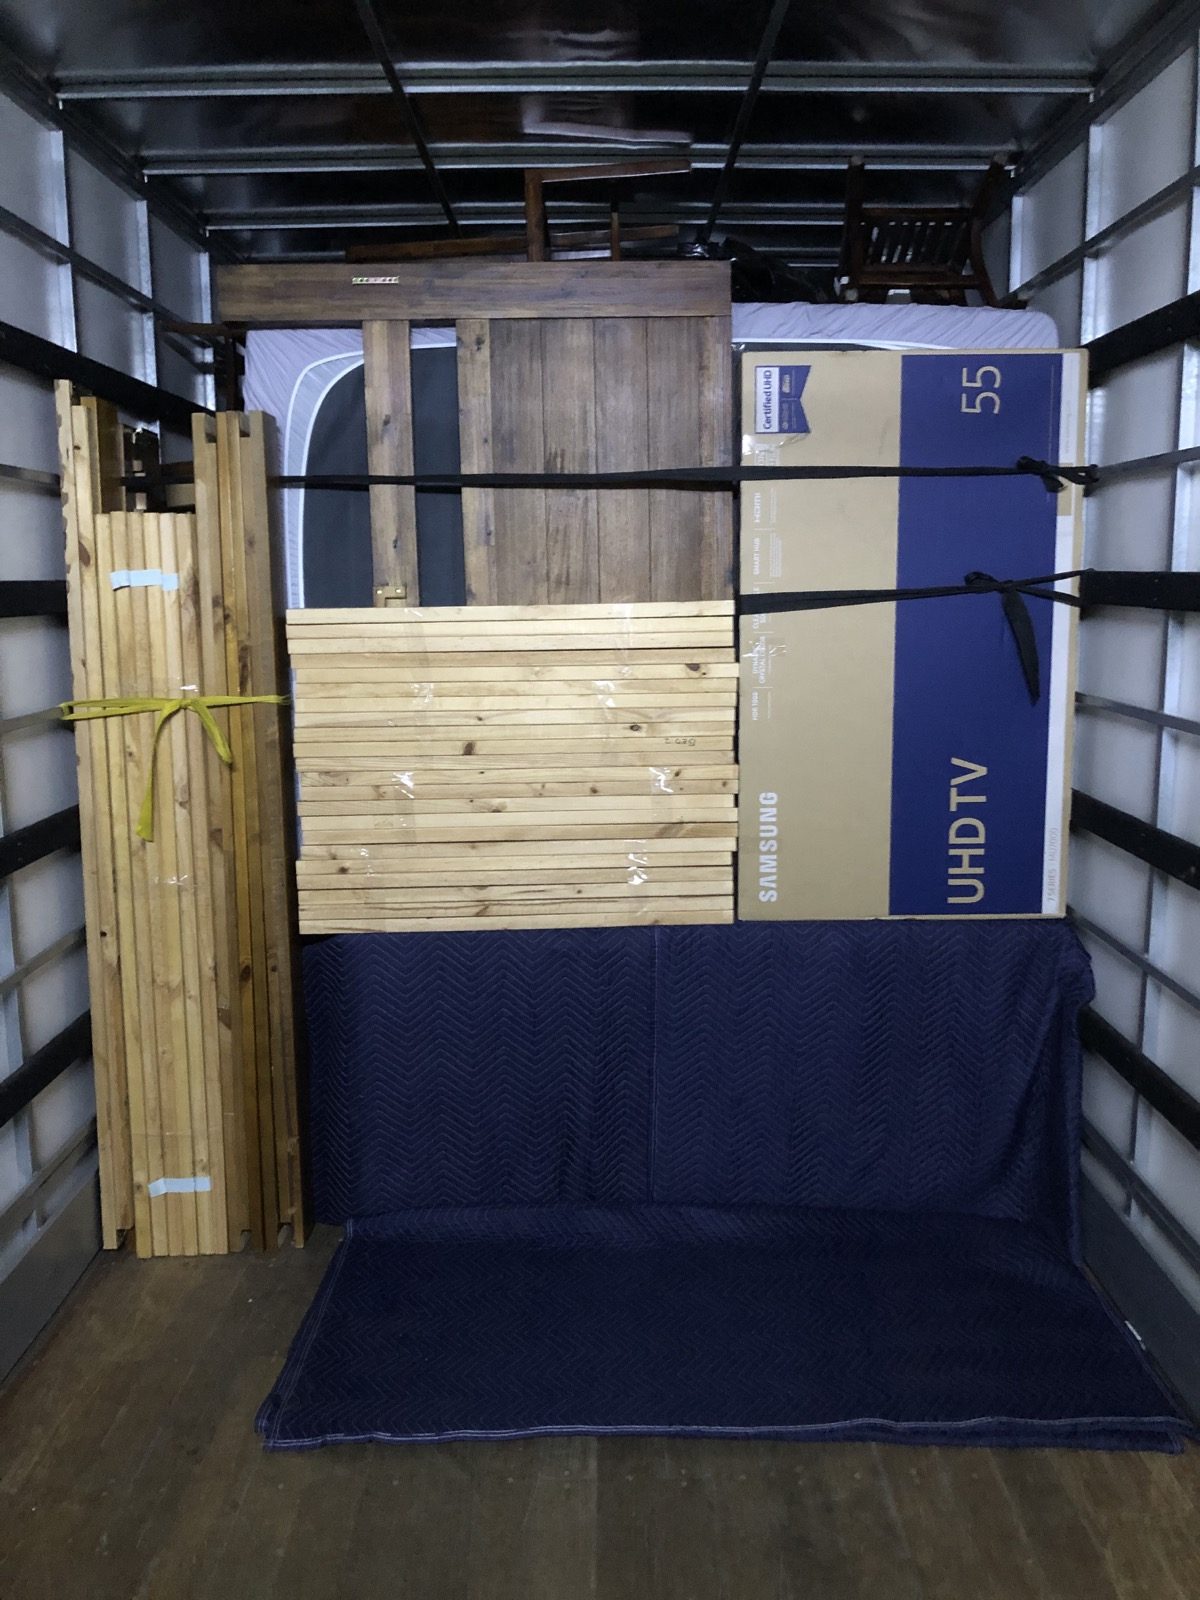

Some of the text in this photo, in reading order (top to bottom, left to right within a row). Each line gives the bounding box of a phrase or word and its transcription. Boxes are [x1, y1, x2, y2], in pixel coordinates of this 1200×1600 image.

[762, 369, 772, 430] Certified UHD
[960, 365, 1001, 414] 55
[758, 791, 778, 903] SAMSUNG
[947, 757, 988, 904] UHD TV
[1047, 868, 1057, 897] SERIES
